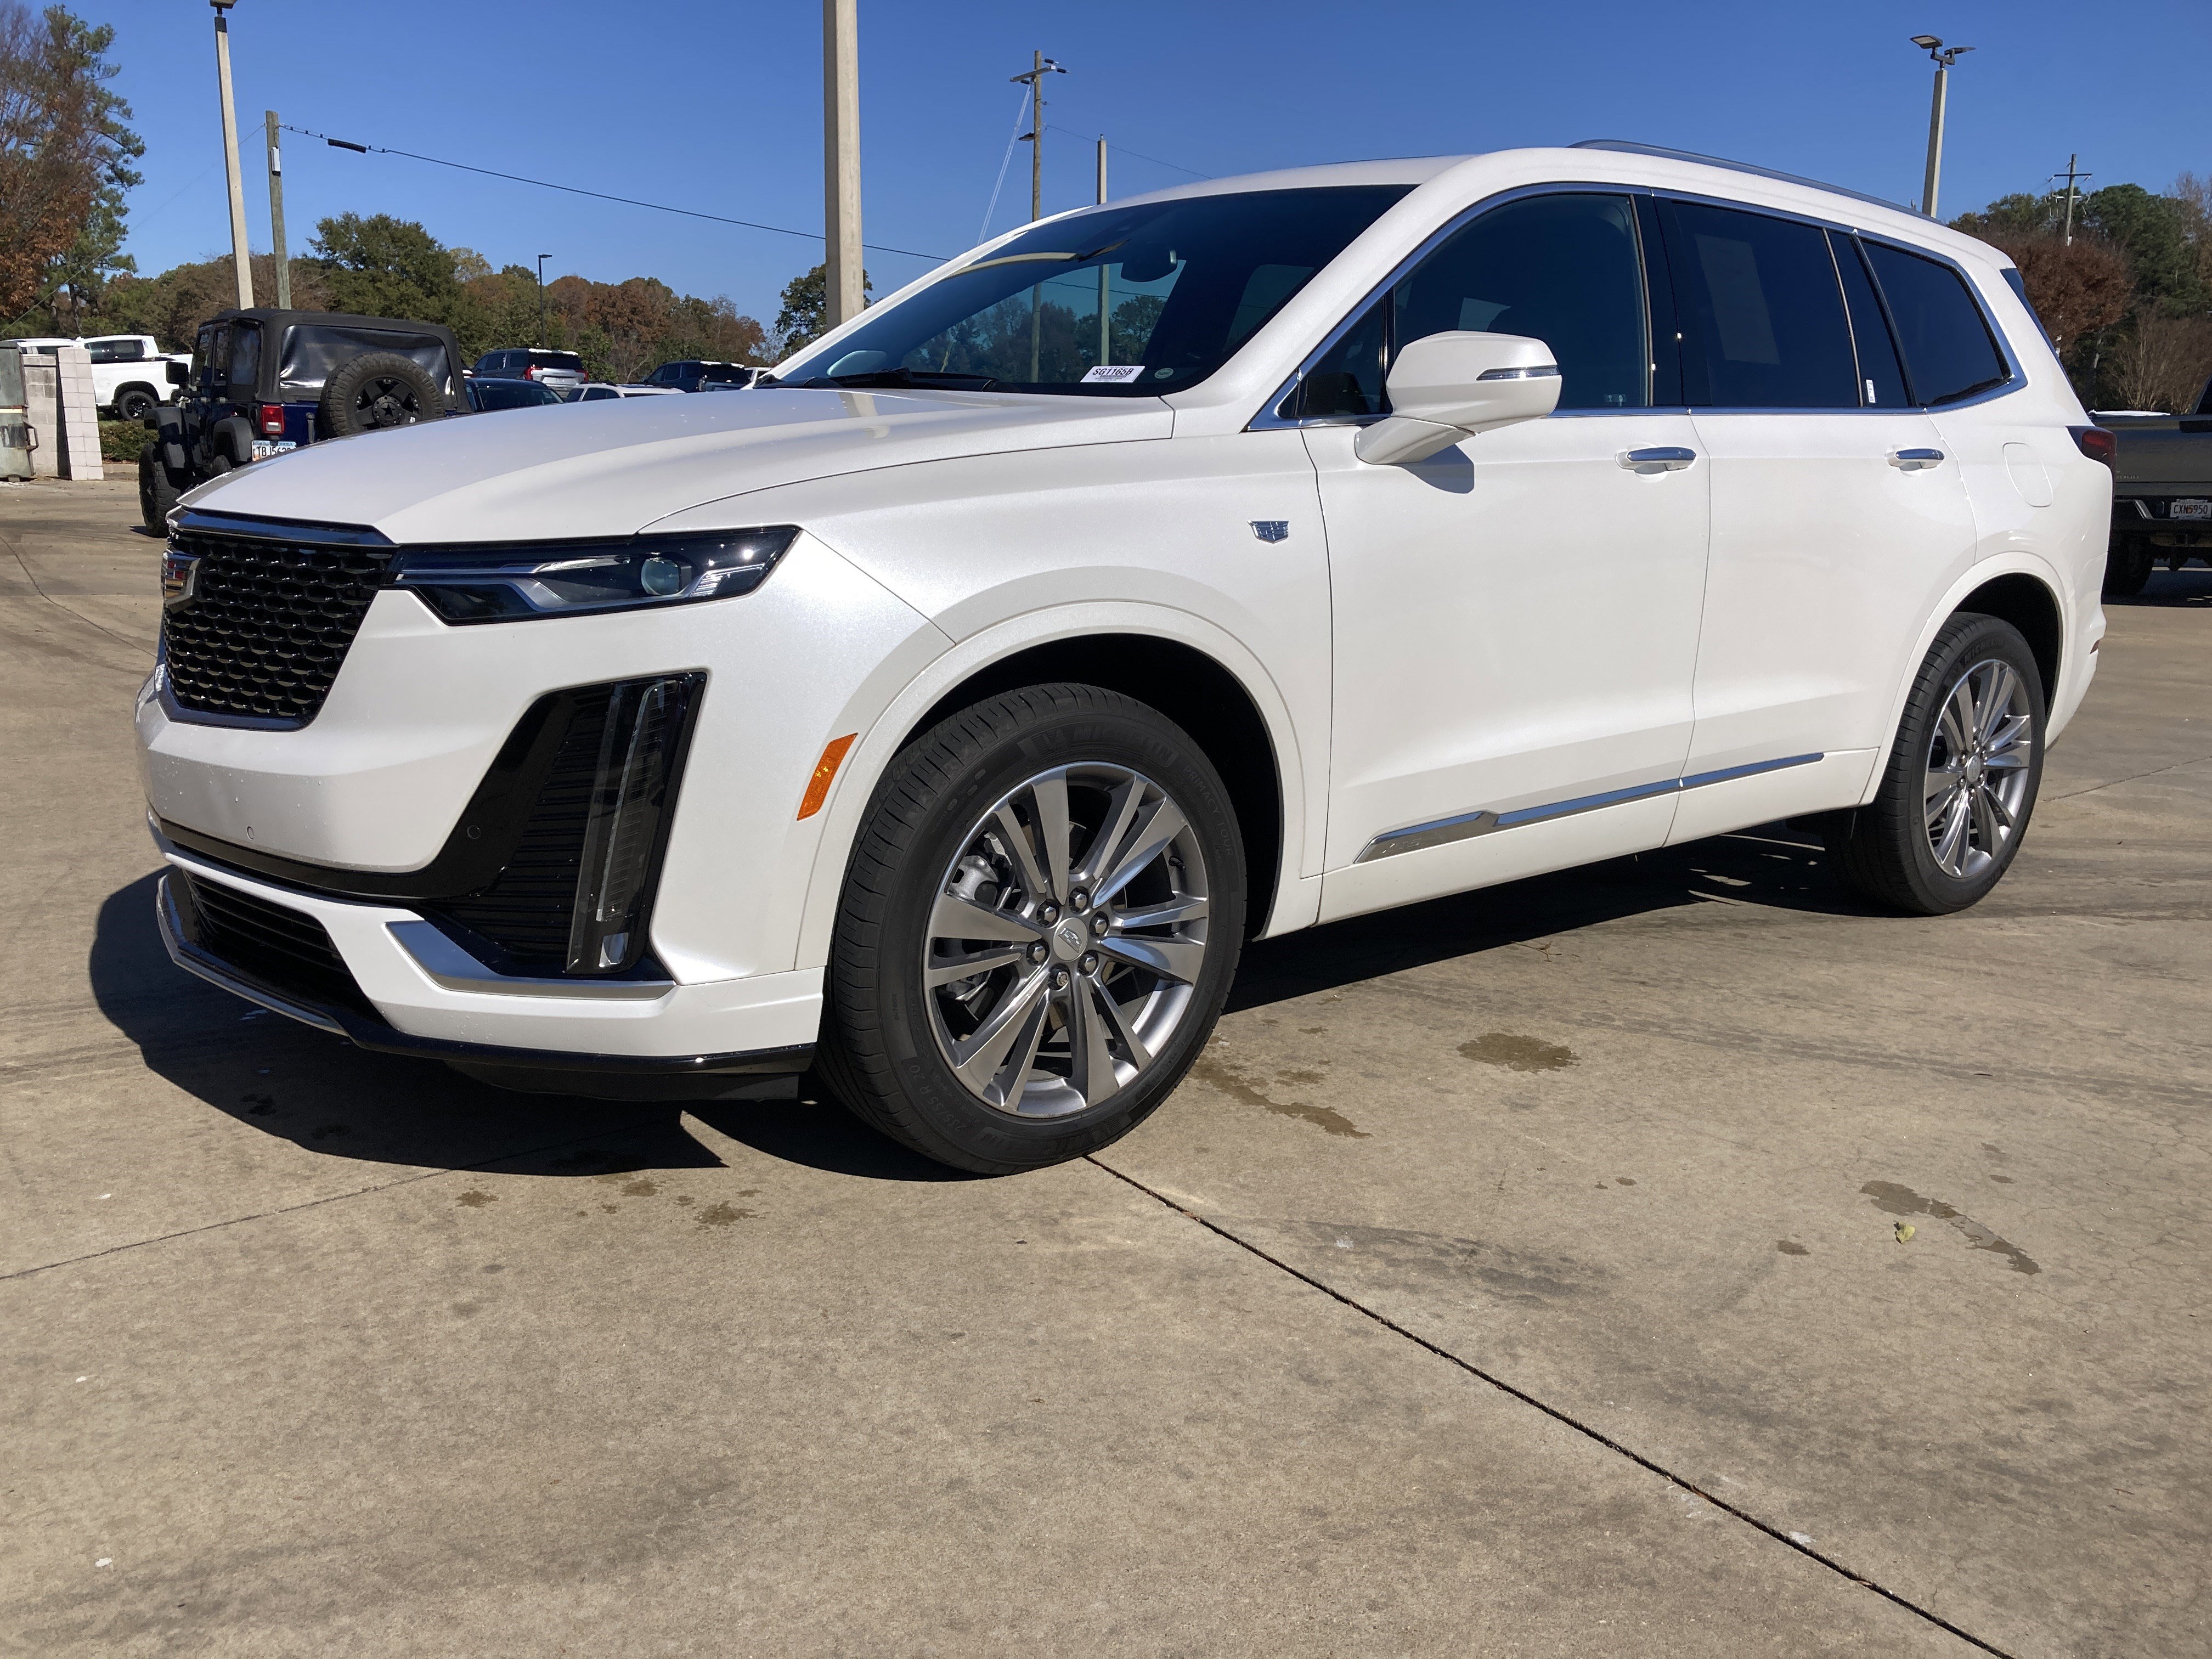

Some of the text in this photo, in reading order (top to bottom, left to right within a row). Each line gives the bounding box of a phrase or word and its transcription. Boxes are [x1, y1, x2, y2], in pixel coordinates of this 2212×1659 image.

[2174, 504, 2208, 514] CXN5950
[1183, 765, 1221, 814] PRIMACY
[1217, 822, 1233, 856] TOUR
[910, 1065, 925, 1081] 20
[919, 1084, 933, 1094] R
[927, 1097, 967, 1132] 235/55
